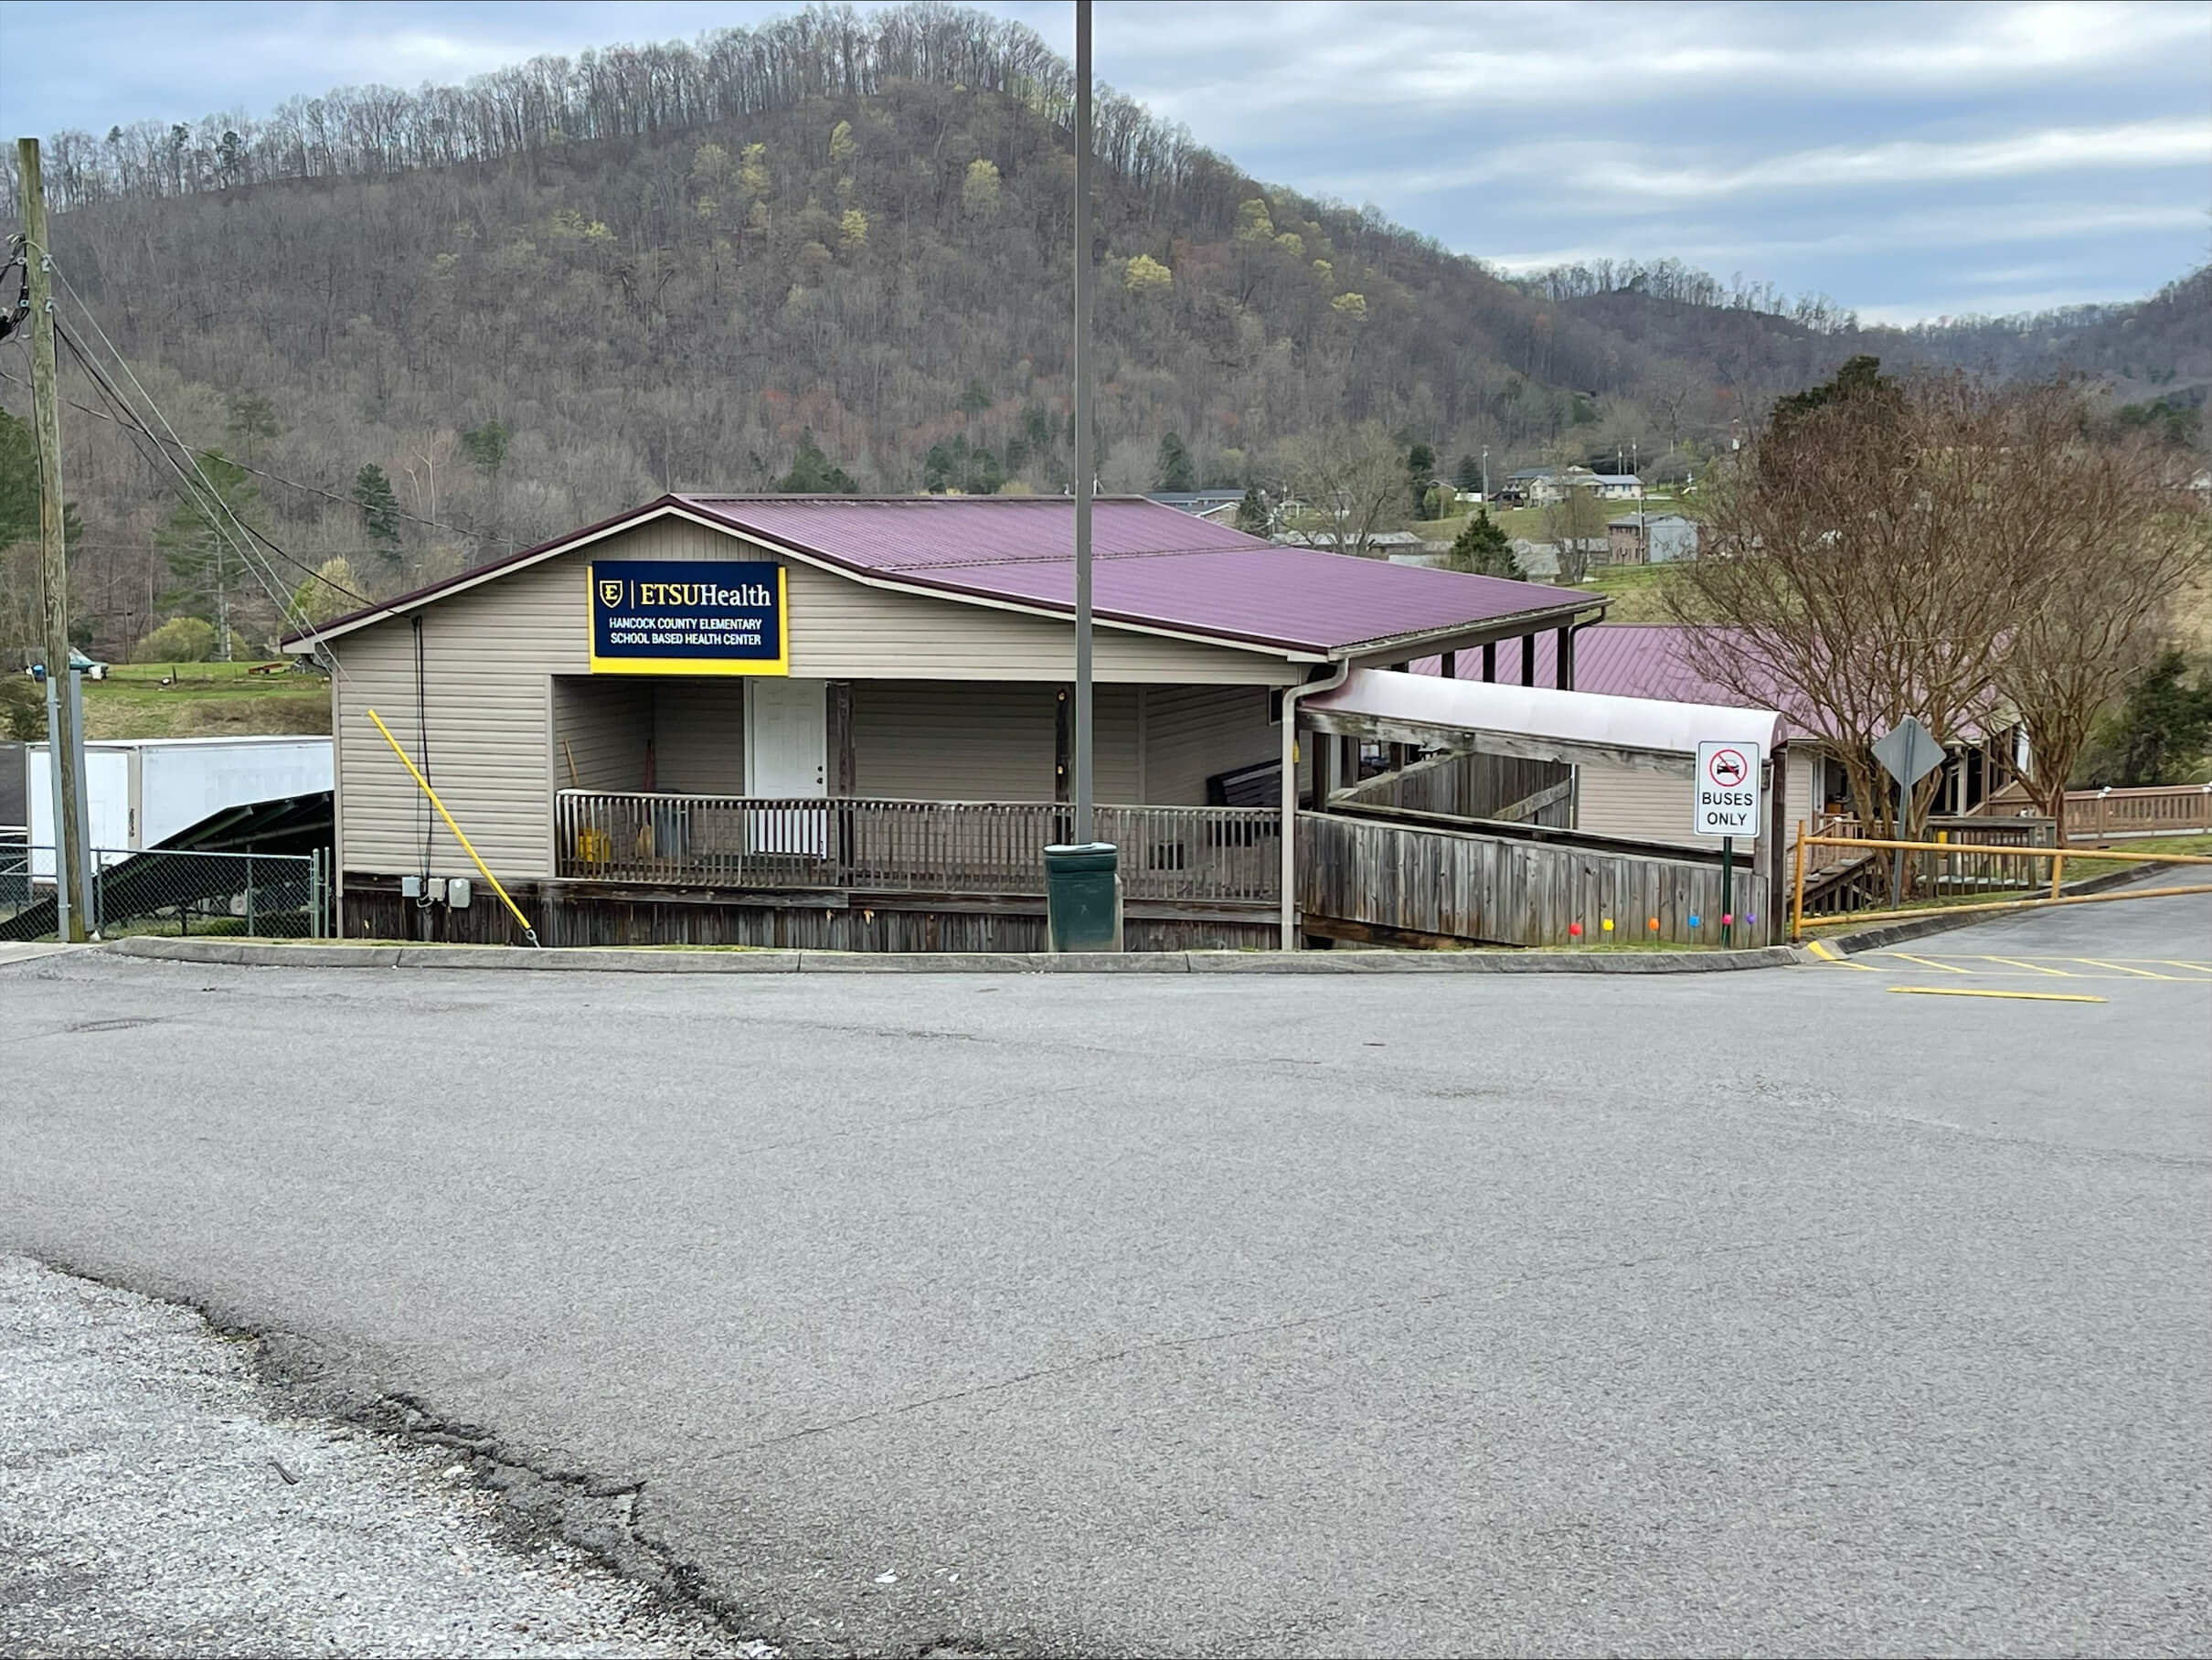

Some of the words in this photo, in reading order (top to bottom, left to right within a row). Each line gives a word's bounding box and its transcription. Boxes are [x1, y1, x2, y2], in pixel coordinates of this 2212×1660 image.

[641, 583, 771, 607] ETSUHealth
[609, 617, 656, 630] HANCOCK
[657, 618, 697, 630] COUNTY
[699, 618, 762, 631] ELEMENTARY
[611, 633, 651, 644] SCHOOL
[652, 633, 684, 644] BASED
[685, 633, 722, 645] HEALTH
[723, 633, 761, 645] CENTER
[1702, 792, 1753, 806] BUSES
[1707, 812, 1747, 826] ONLY
